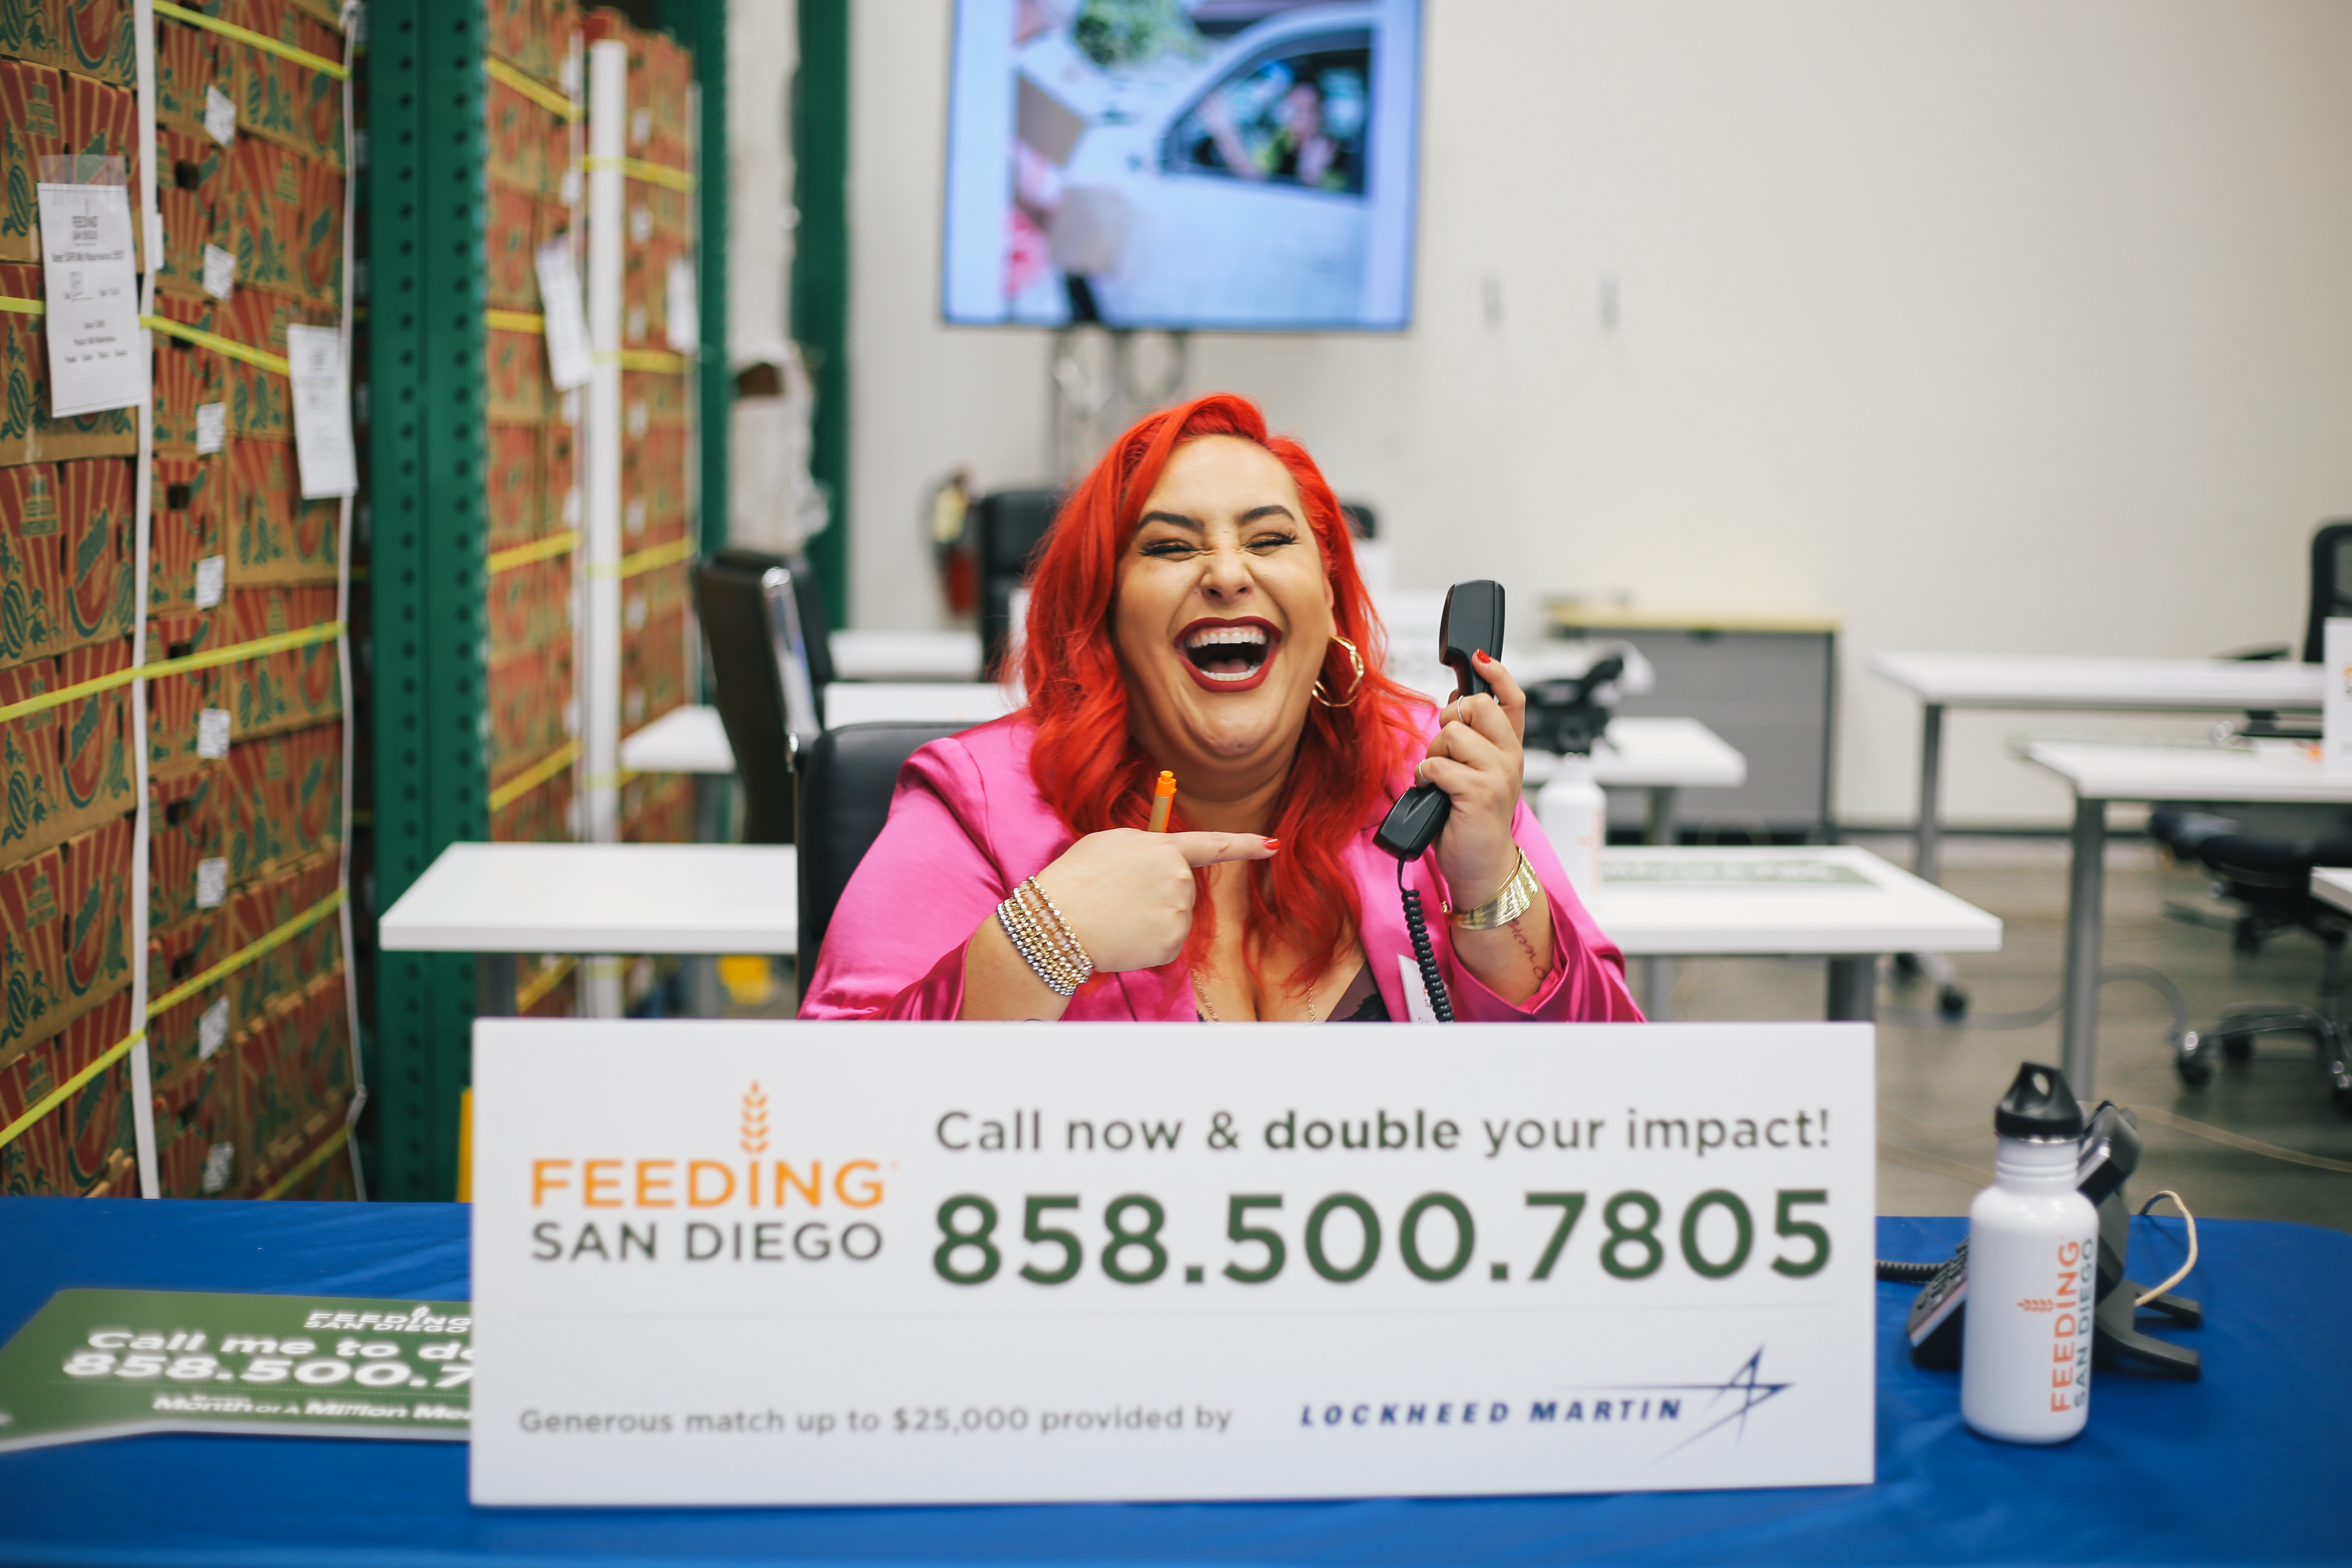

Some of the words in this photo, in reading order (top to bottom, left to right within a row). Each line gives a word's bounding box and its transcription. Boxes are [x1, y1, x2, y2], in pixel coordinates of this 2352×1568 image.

[935, 1109, 1041, 1151] Call
[1066, 1120, 1183, 1151] now
[1205, 1110, 1239, 1151] &
[1263, 1109, 1461, 1151] double
[1483, 1119, 1605, 1159] your
[1627, 1108, 1829, 1157] impact!
[532, 1159, 883, 1208] FEEDING
[532, 1221, 657, 1261] SAN
[686, 1221, 883, 1261] DIEGO
[932, 1188, 1832, 1287] 858.500.7805
[2079, 1239, 2093, 1336] DIEGO
[303, 1321, 364, 1330] SAN
[372, 1323, 468, 1333] DIEGO
[308, 1313, 473, 1326] FEEDING
[2051, 1241, 2080, 1413] FEEDING
[87, 1331, 207, 1351] Call
[220, 1339, 316, 1354] me
[336, 1341, 399, 1357] to
[62, 1354, 474, 1388] 858.500.7
[2074, 1346, 2088, 1408] SAN
[151, 1396, 254, 1412] Month
[304, 1401, 408, 1417] Million
[519, 1409, 673, 1433] Generous
[686, 1410, 784, 1432] match
[796, 1414, 836, 1435] up
[848, 1410, 880, 1430] to
[893, 1406, 1028, 1434] $25,000
[1041, 1407, 1183, 1435] provided
[1196, 1406, 1232, 1432] by
[1301, 1401, 1510, 1427] LOCKHEED
[1528, 1398, 1682, 1423] MARTIN
